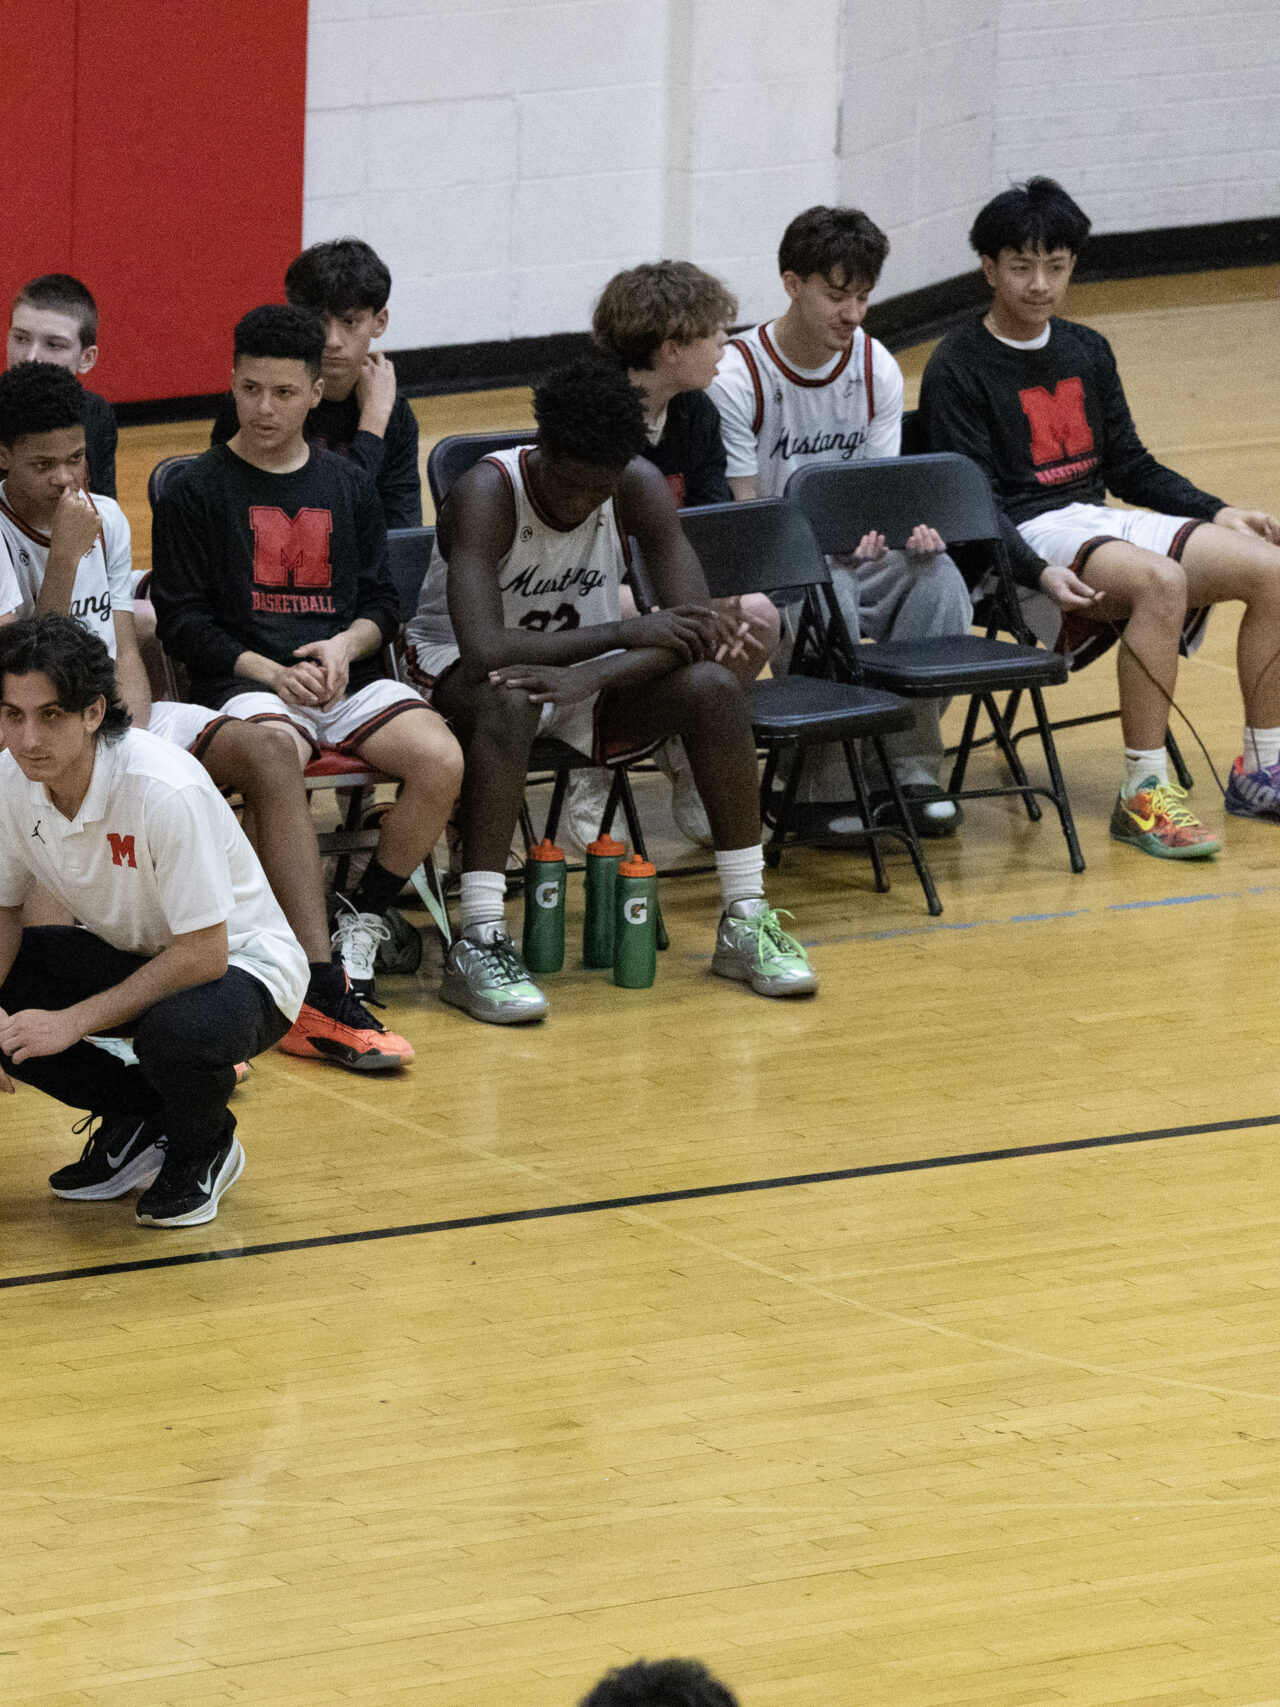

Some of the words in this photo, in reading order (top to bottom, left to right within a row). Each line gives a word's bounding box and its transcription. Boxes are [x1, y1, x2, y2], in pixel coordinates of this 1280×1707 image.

[1018, 376, 1094, 466] M
[249, 505, 333, 587] M
[251, 591, 336, 613] BASKETBALL
[106, 832, 137, 870] M
[535, 880, 559, 909] G
[623, 896, 648, 925] G
